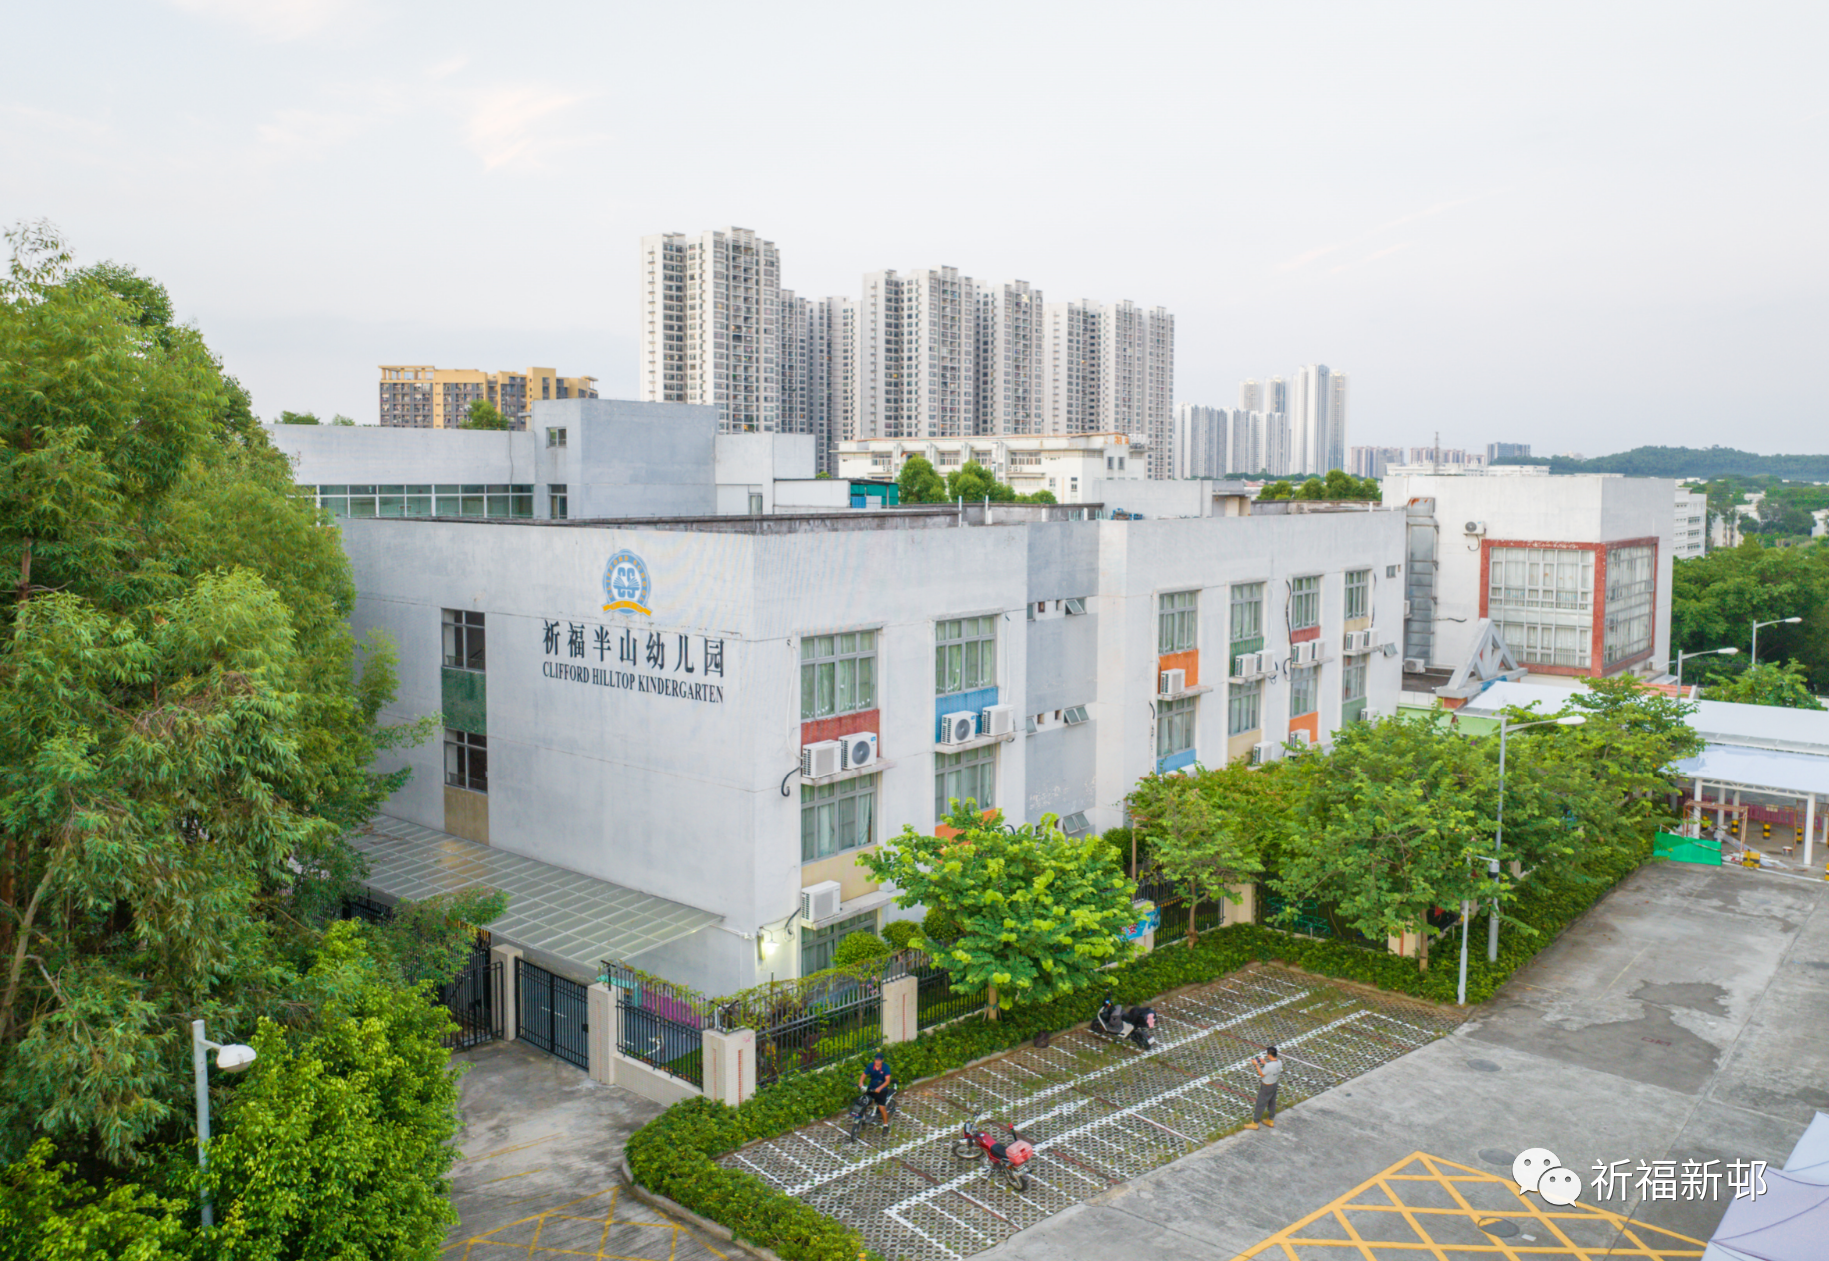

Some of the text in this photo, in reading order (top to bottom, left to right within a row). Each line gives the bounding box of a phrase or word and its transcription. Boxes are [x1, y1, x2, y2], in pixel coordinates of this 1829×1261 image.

[542, 619, 724, 678] 祈福半山幼儿园
[542, 661, 724, 704] CLIFFORD HILLTOP KINDERGARTEN
